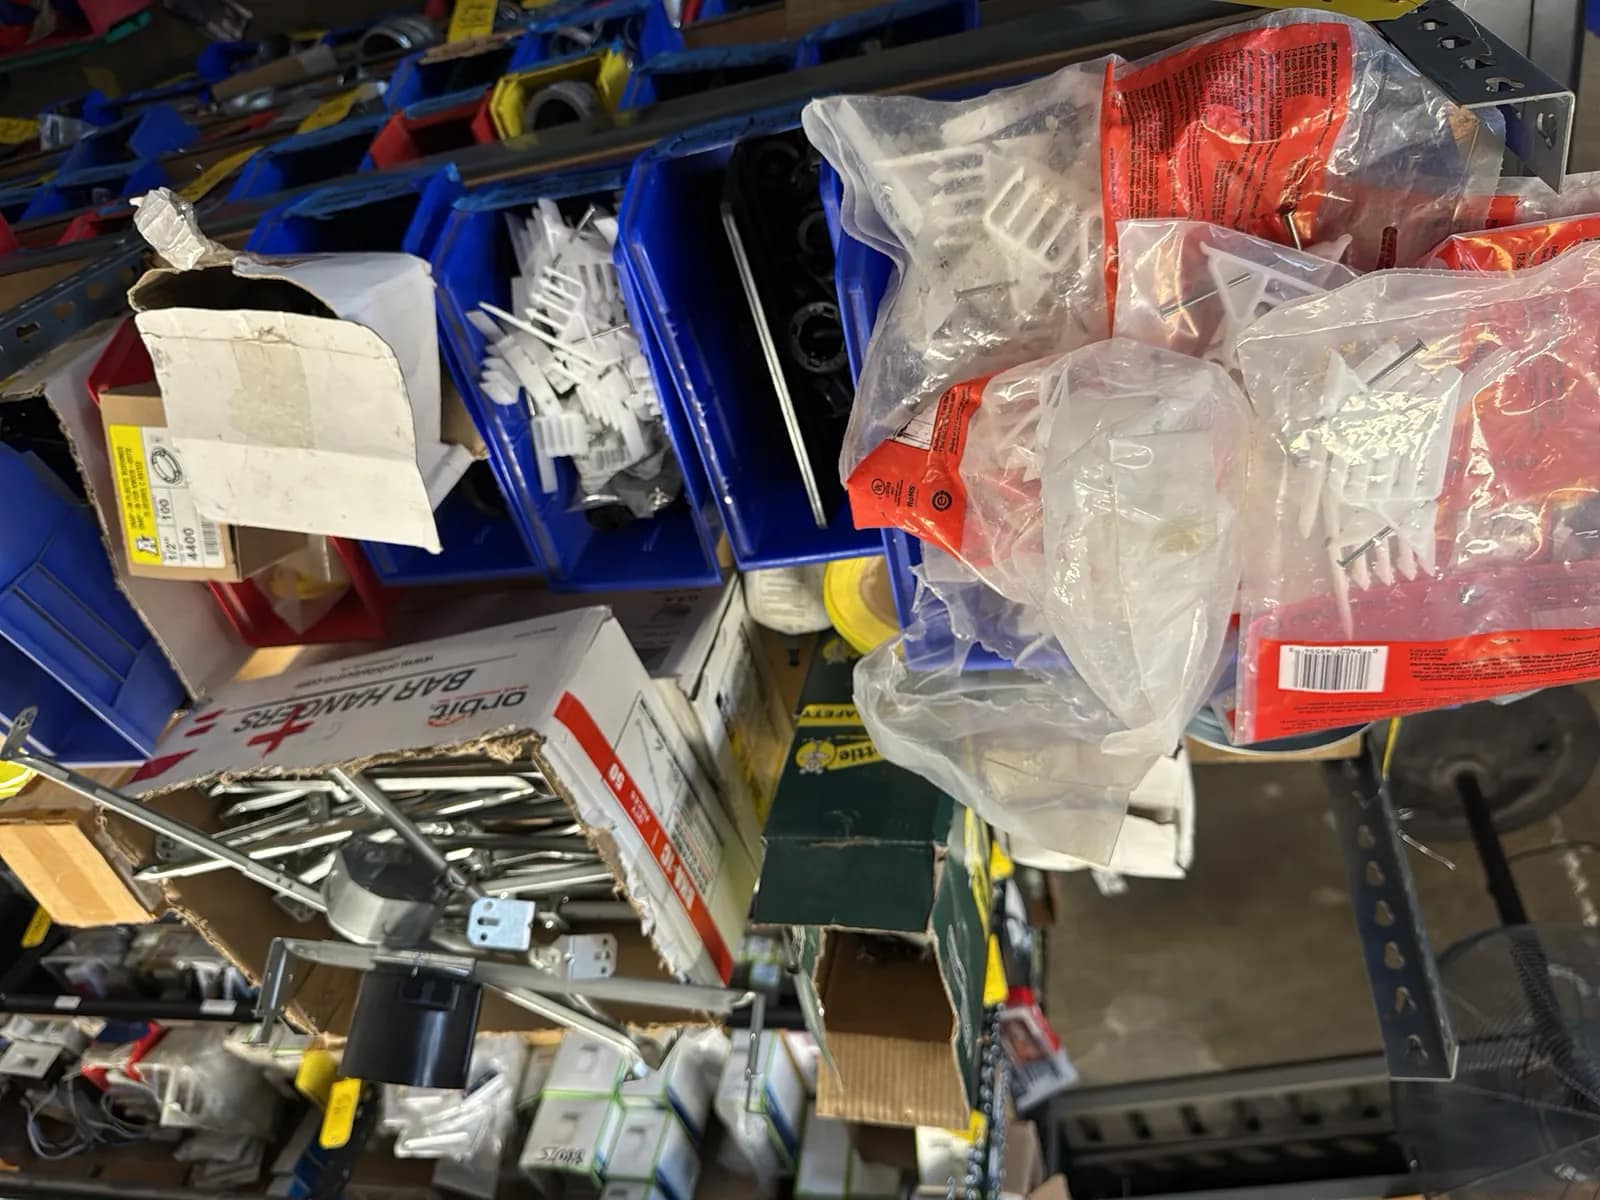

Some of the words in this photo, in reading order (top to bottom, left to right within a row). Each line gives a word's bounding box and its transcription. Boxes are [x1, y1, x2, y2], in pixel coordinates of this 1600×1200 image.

[159, 498, 171, 520] 100
[183, 527, 199, 560] 4400
[393, 669, 476, 702] BAR
[233, 686, 392, 733] HANGERS
[428, 691, 527, 719] orbit
